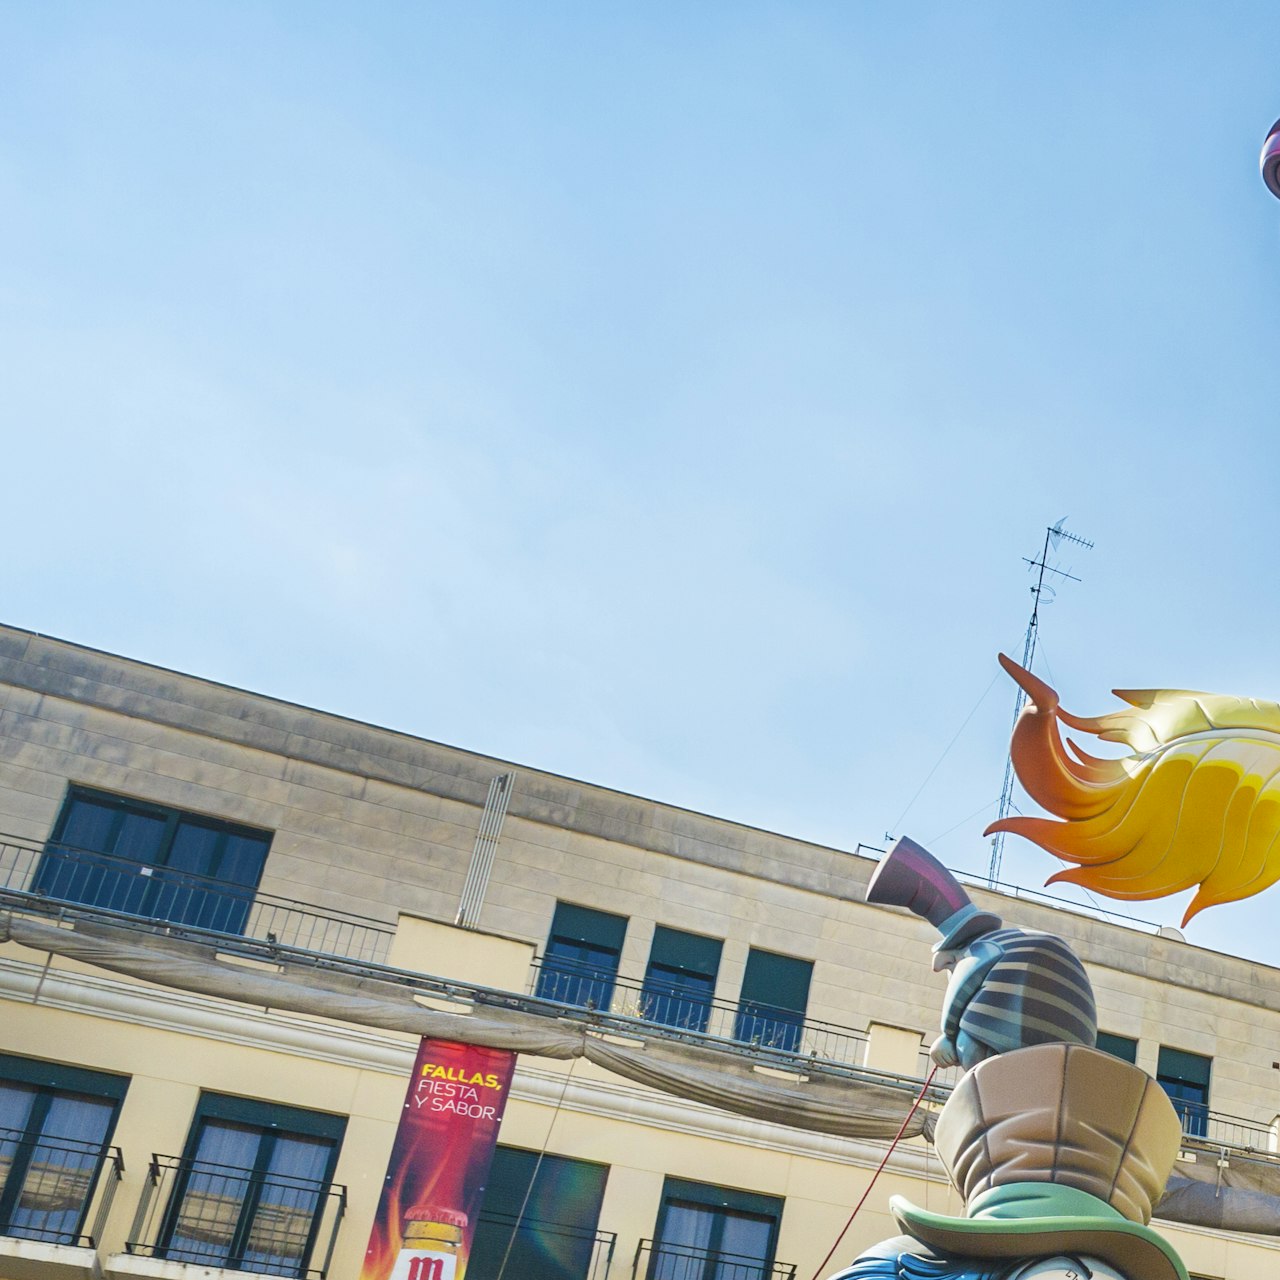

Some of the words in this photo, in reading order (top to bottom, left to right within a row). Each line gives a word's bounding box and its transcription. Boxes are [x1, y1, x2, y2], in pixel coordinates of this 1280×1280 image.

[417, 1079, 479, 1102] FIESTA
[421, 1063, 503, 1091] FALLAS,
[414, 1094, 429, 1109] Y
[430, 1097, 496, 1121] SABOR
